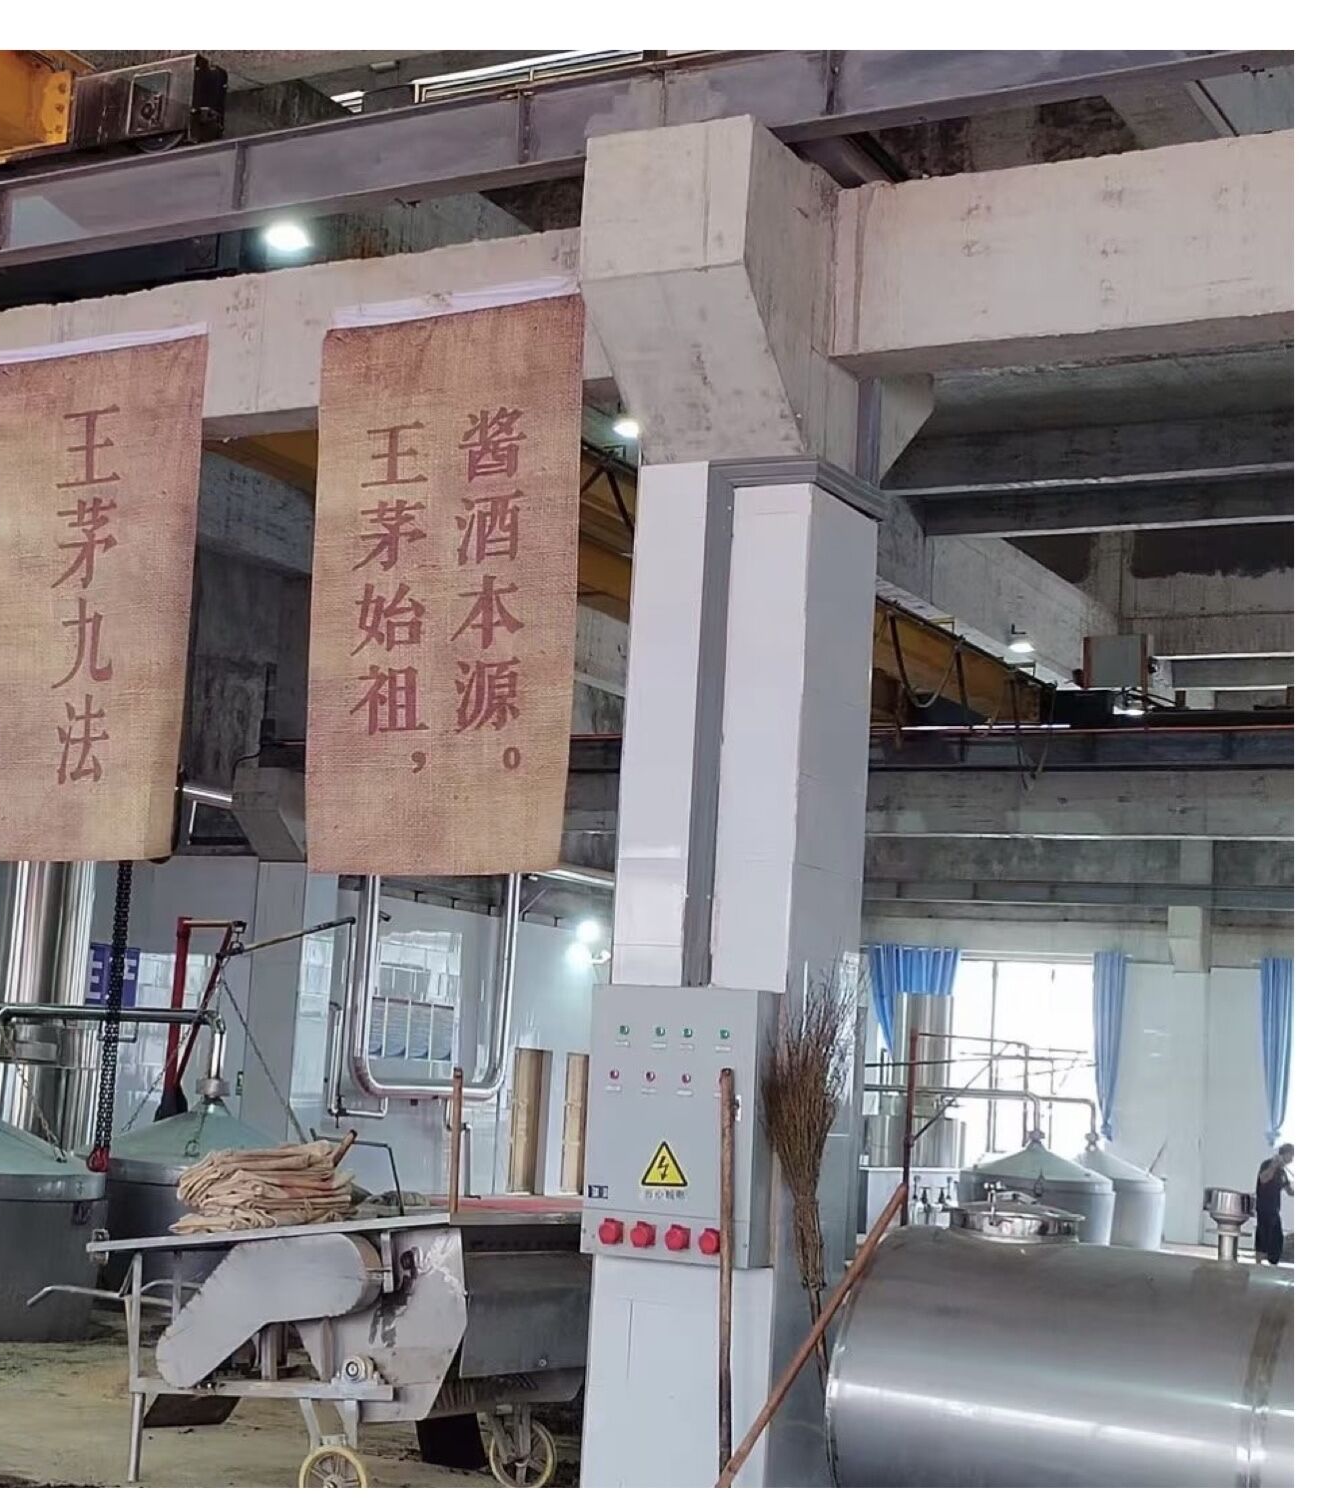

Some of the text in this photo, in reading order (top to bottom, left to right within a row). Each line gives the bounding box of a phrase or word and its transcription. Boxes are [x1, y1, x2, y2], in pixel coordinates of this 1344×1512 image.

[50, 404, 121, 785] 王茅九法
[349, 421, 430, 774] 王茅始祖，
[450, 406, 527, 771] 酱酒本源。
